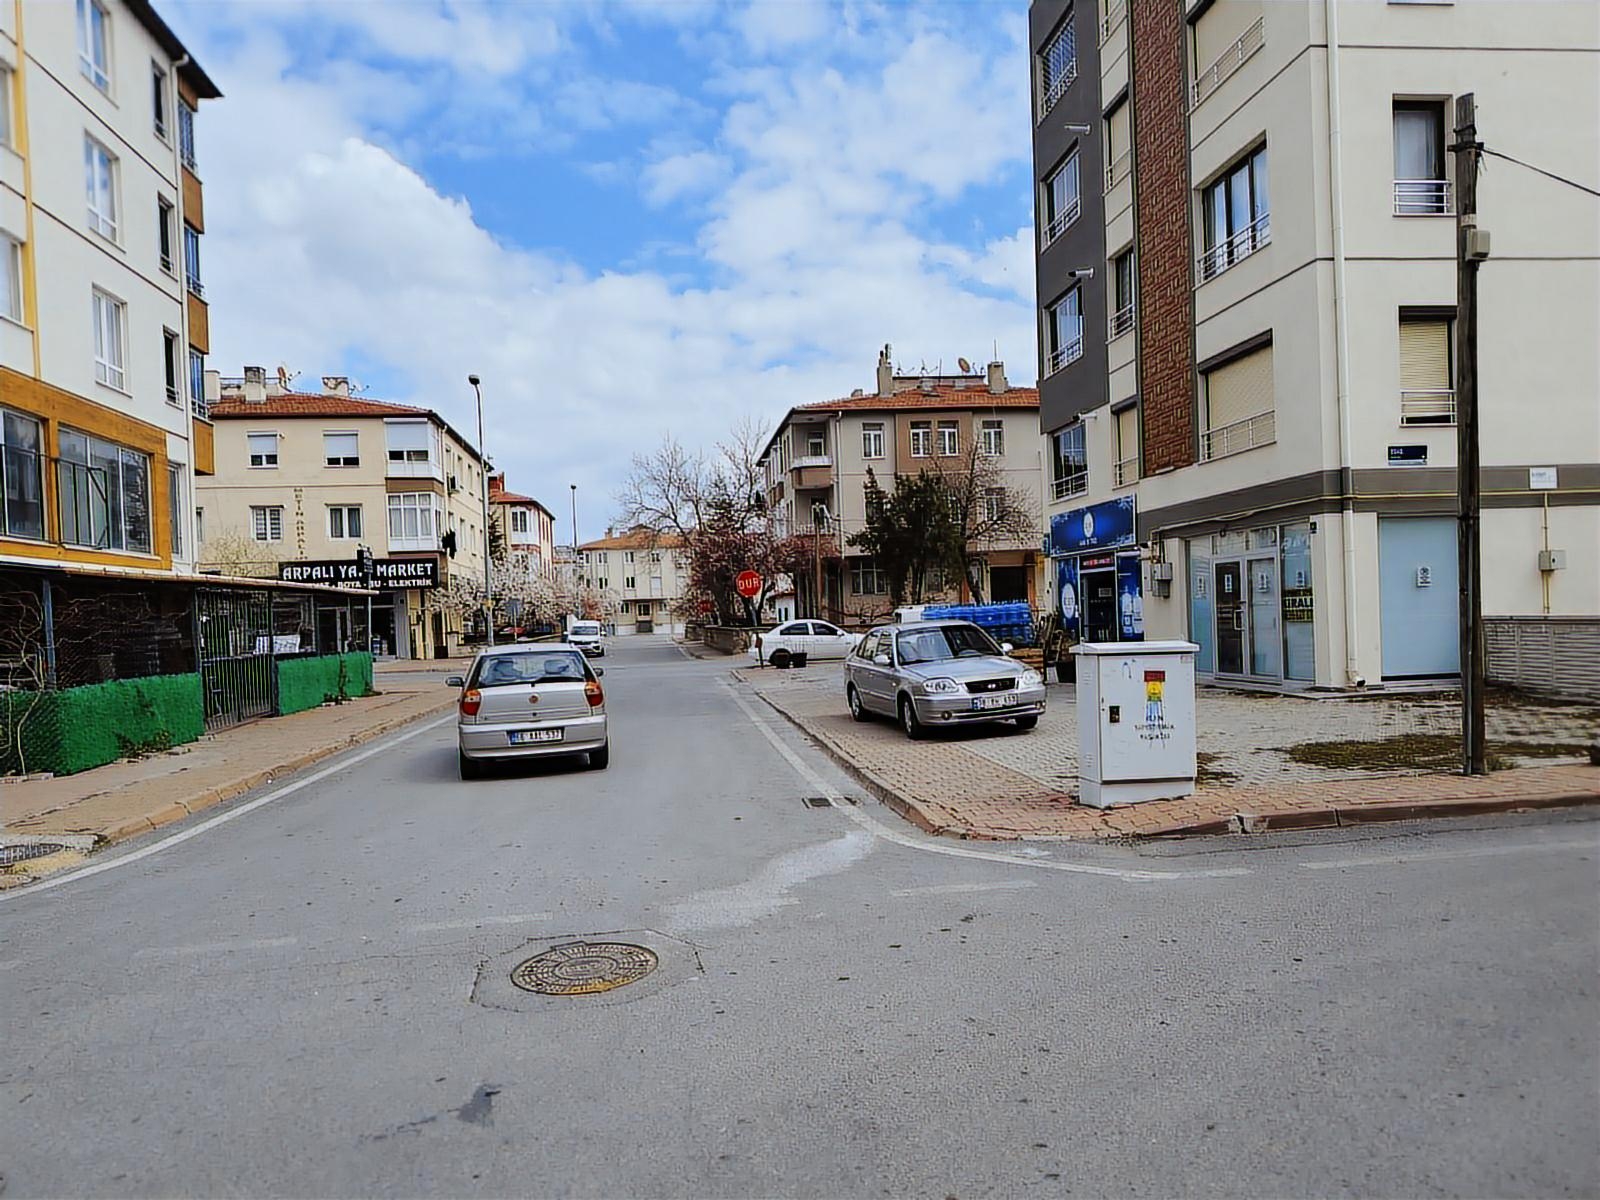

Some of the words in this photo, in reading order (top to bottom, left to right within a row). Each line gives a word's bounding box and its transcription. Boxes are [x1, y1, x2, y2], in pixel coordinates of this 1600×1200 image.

[282, 566, 334, 580] ARPALI
[376, 563, 433, 577] MARKET
[388, 577, 433, 588] ELEKTRİK
[738, 577, 760, 590] DUR
